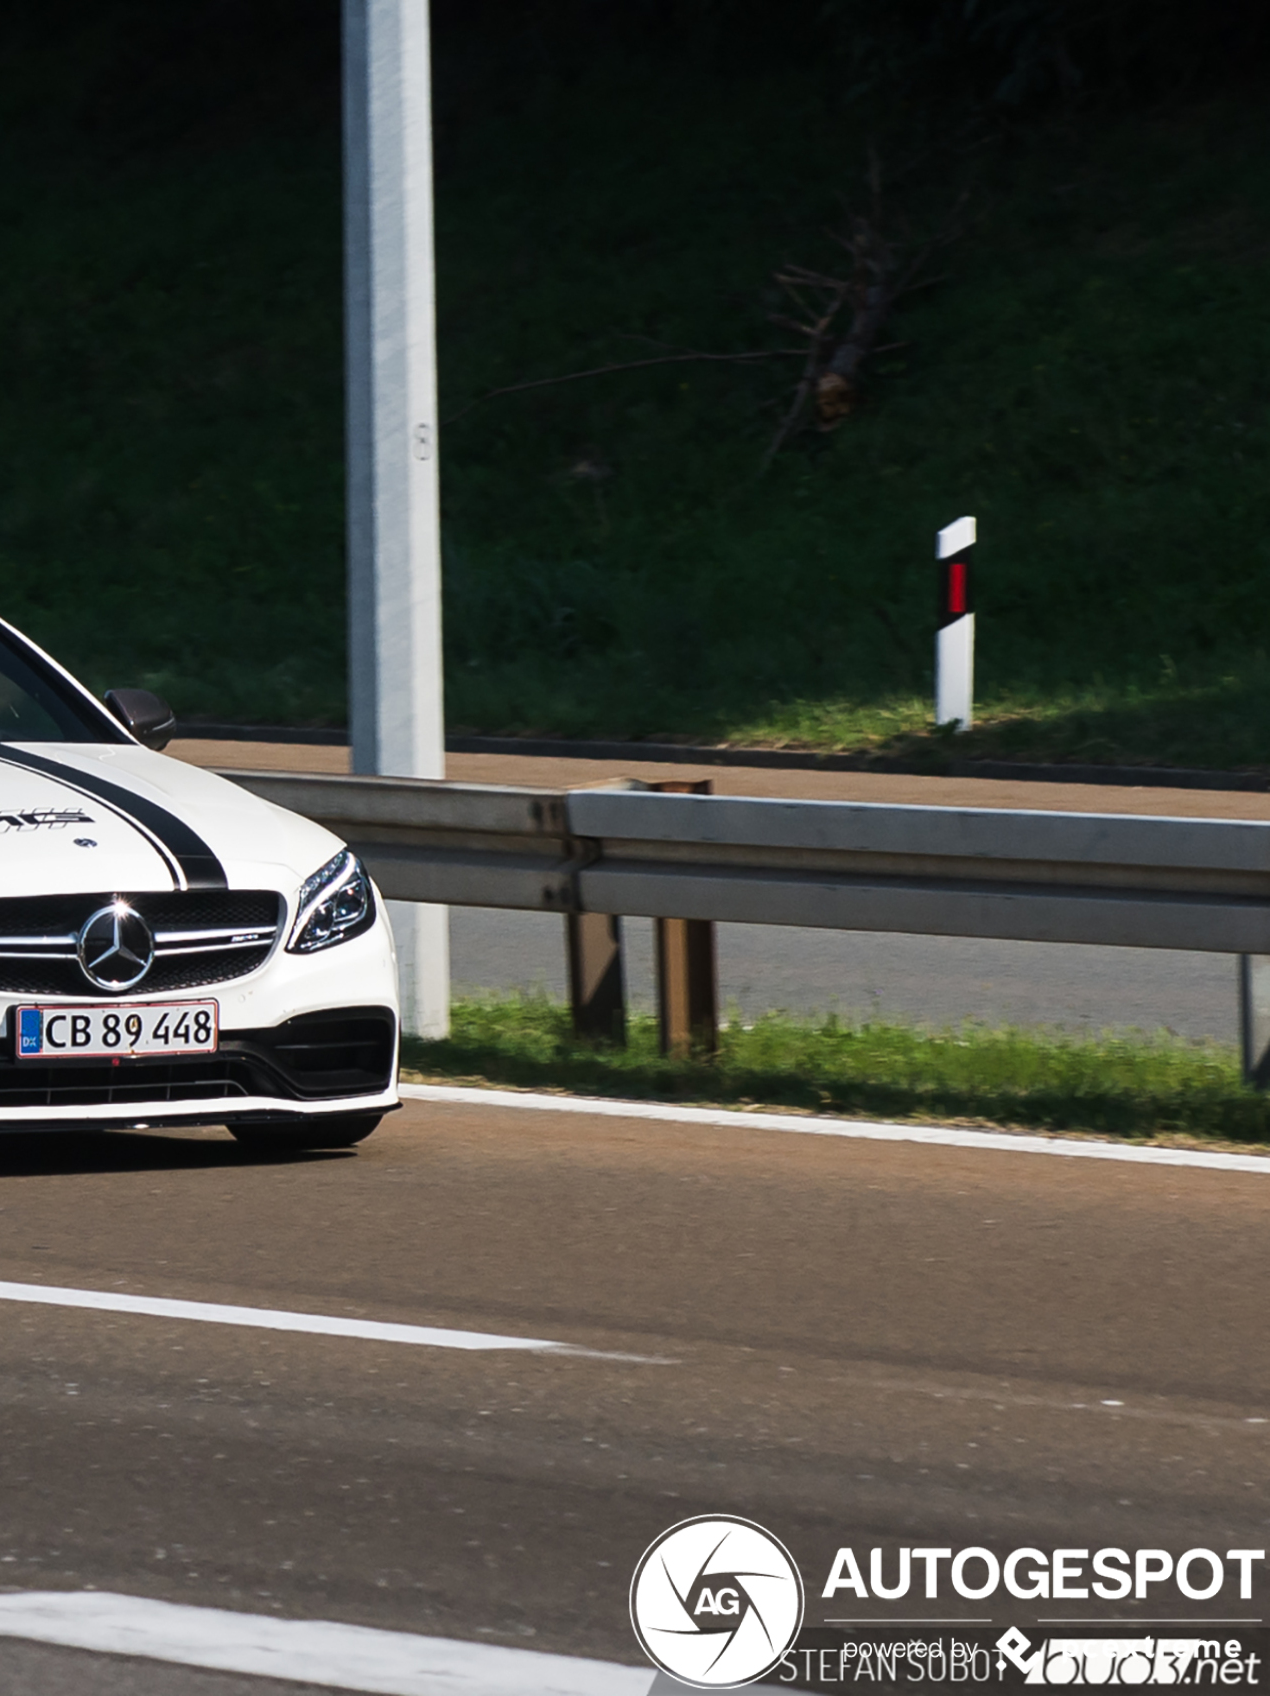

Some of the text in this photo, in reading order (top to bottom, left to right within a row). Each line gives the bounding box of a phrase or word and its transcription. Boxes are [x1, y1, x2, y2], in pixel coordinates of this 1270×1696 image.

[45, 1010, 212, 1048] CB 89 448
